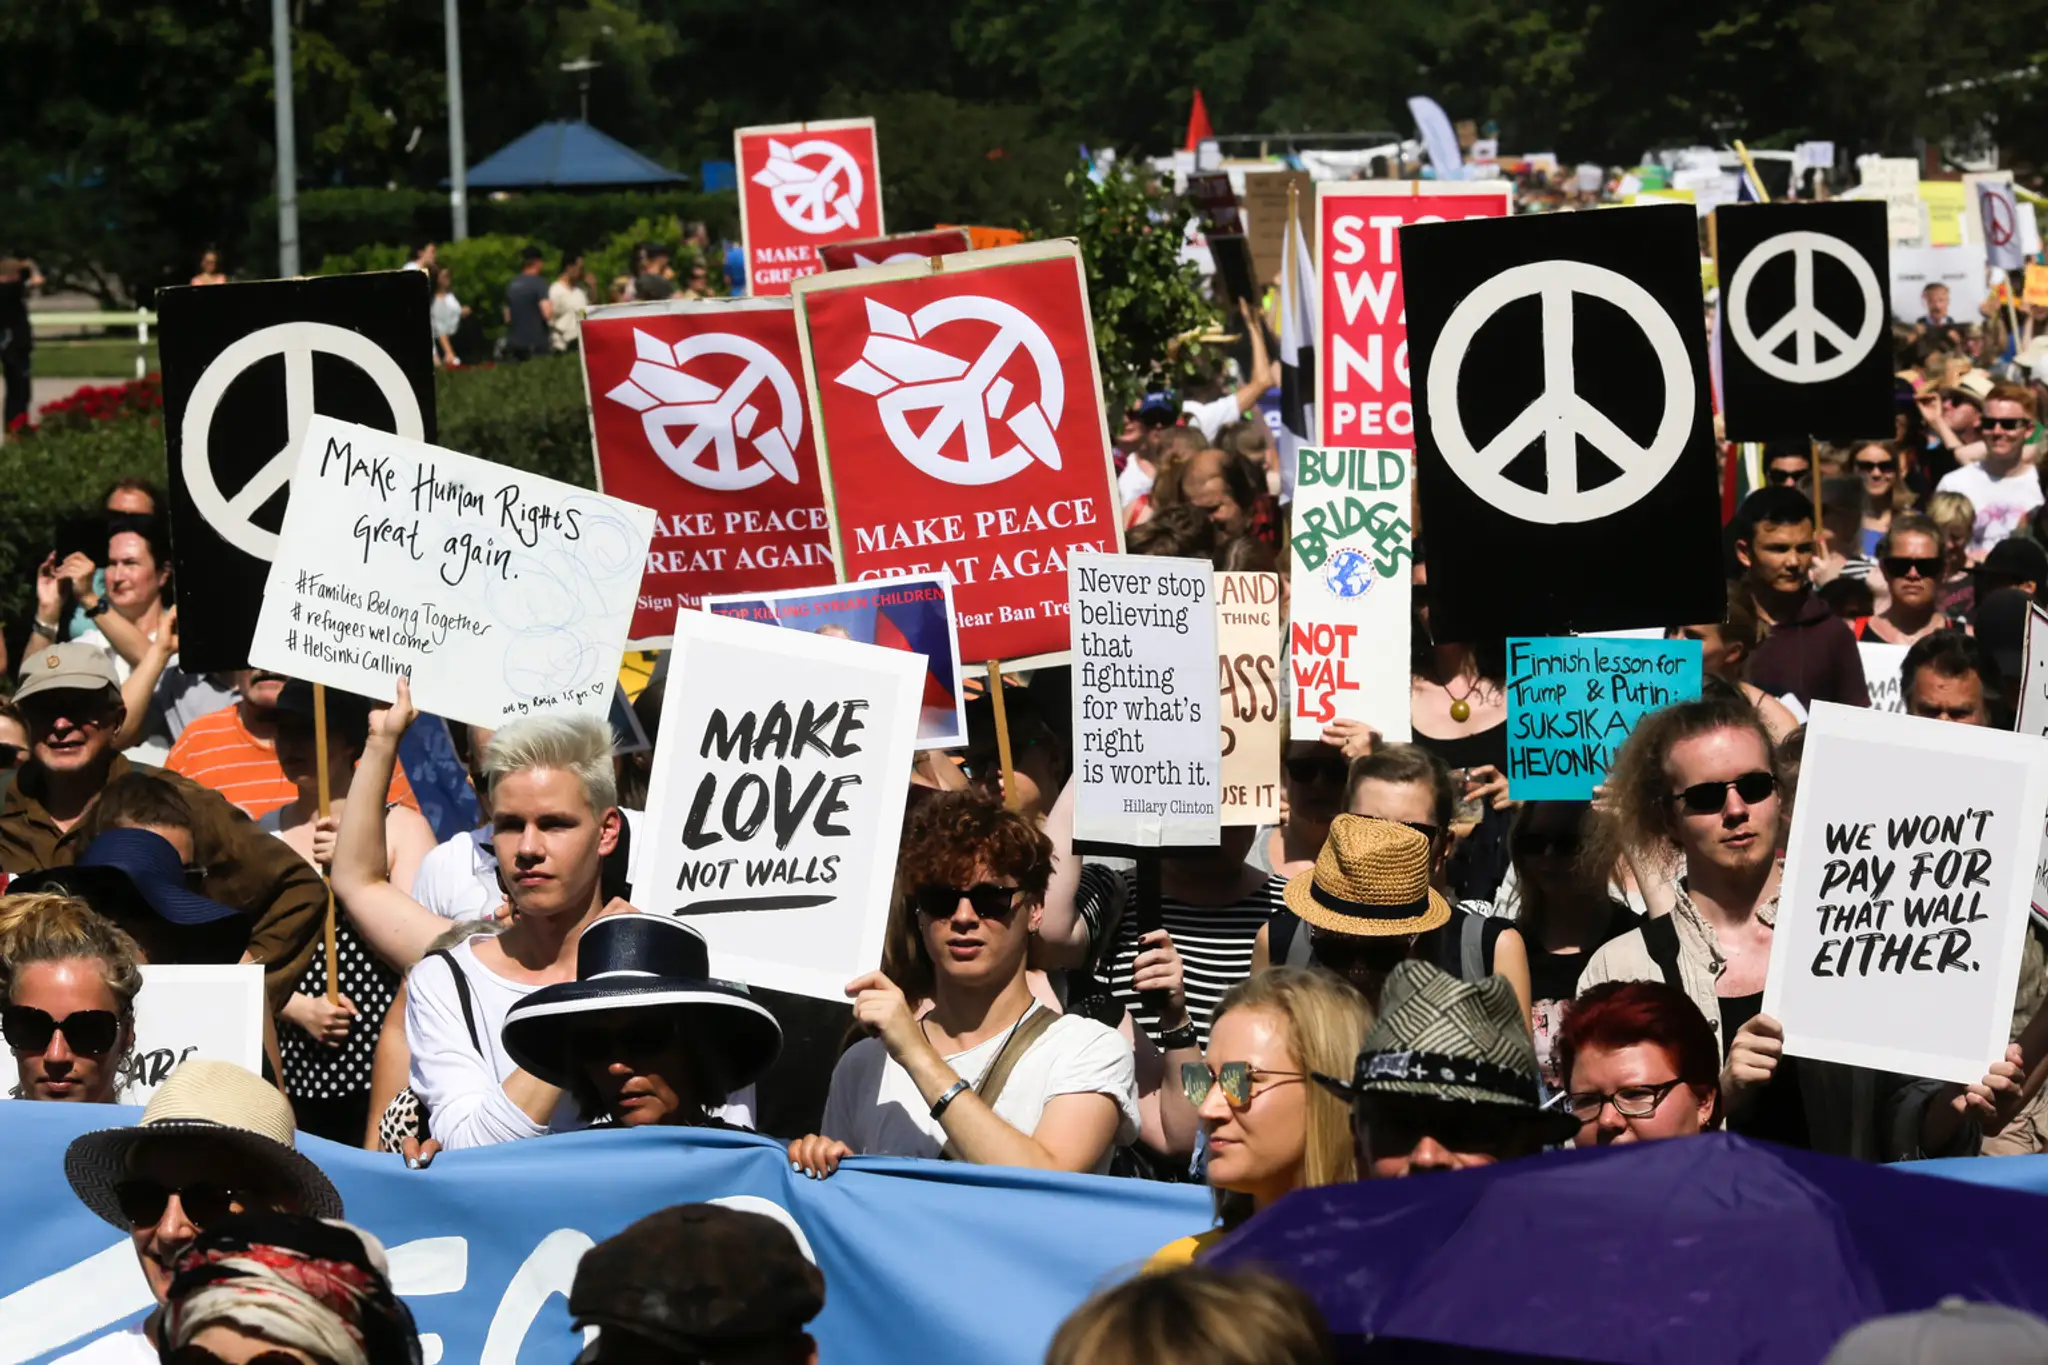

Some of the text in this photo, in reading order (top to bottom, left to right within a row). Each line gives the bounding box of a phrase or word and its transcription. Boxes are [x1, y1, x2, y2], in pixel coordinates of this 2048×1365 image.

[755, 244, 811, 264] MAKE
[1333, 270, 1406, 325] W
[1333, 402, 1413, 435] PEO
[1298, 449, 1405, 491] BUILD
[411, 463, 484, 516] Human
[652, 507, 831, 538] AKE PEACE
[854, 497, 1097, 554] MAKE PEACE
[1291, 497, 1413, 578] BRIDGES
[353, 514, 519, 586] Great again.
[647, 549, 726, 574] REAT
[1078, 567, 1206, 602] Never stop
[1216, 573, 1278, 605] AND
[637, 595, 672, 611] Sign
[753, 603, 809, 620] KILLING
[814, 596, 868, 615] SYRIAN
[872, 587, 944, 607] CHILDREN
[998, 605, 1036, 623] Ban
[1040, 600, 1071, 617] Tre
[1078, 600, 1189, 634] believing
[1081, 632, 1133, 658] that
[1292, 621, 1358, 658] NOT
[1292, 658, 1360, 693] WAL
[1510, 642, 1686, 677] Finnish lesson for
[1081, 662, 1175, 695] fighting
[1508, 672, 1567, 707] Trump
[1587, 678, 1605, 702] &
[1083, 694, 1202, 723] for what's
[1297, 688, 1336, 723] LS
[700, 699, 869, 763] MAKE
[1513, 708, 1649, 740] SUKSIKA
[1083, 727, 1144, 759] right
[1083, 759, 1211, 787] is worth it.
[682, 765, 862, 851] LOVE
[1123, 799, 1214, 817] Hillary Clinton
[1256, 784, 1275, 808] IT
[1826, 807, 1994, 854] WE WON'T
[676, 855, 840, 892] NOT WALLS
[1819, 849, 1991, 900] PAY FOR
[1817, 891, 1989, 935] THAT WALL
[1811, 928, 1979, 977] EITHER.
